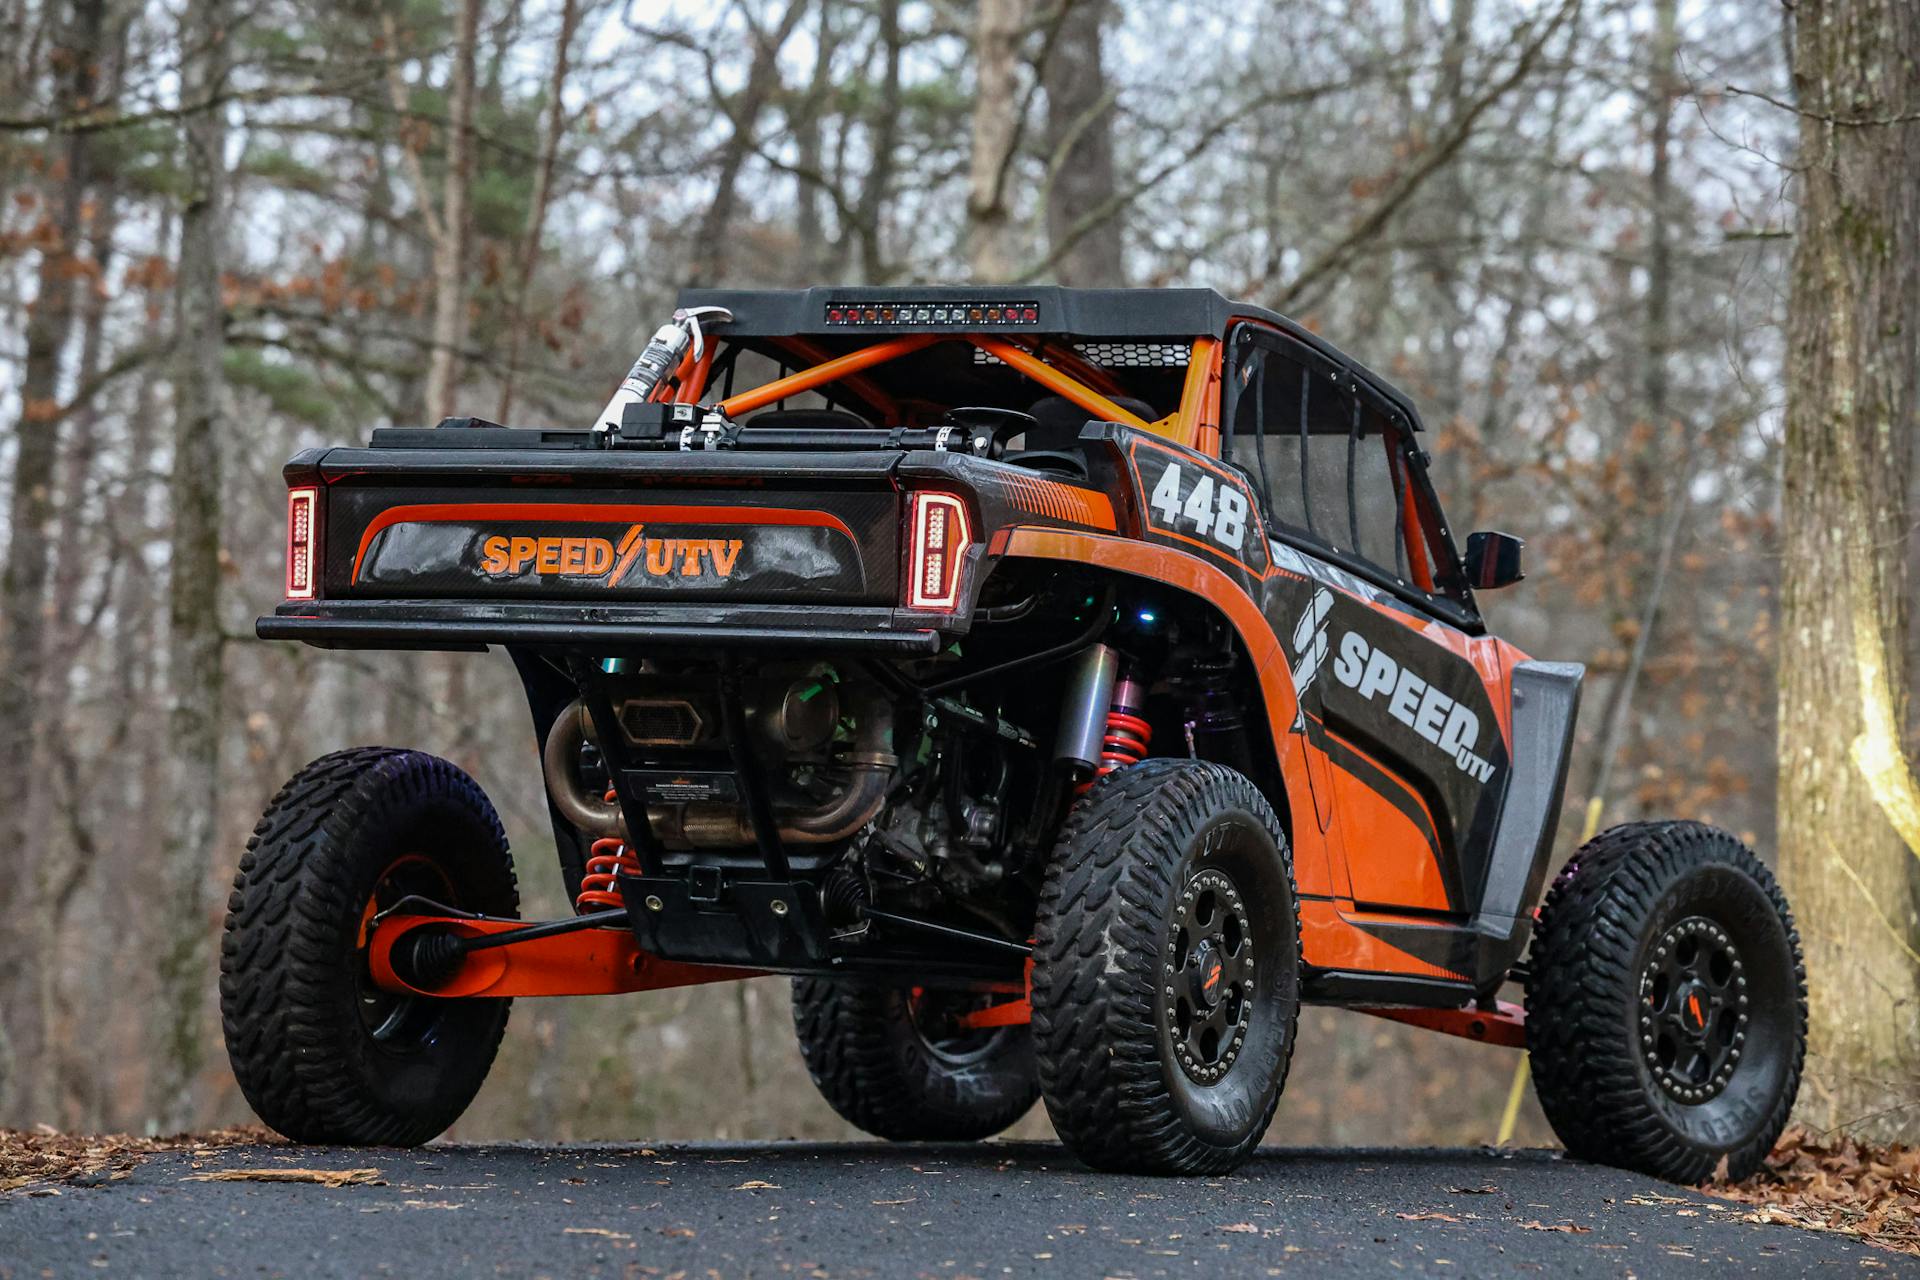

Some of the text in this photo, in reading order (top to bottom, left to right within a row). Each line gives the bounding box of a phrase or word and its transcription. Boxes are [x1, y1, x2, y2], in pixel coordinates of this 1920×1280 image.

[1150, 462, 1248, 550] 448
[481, 536, 743, 577] SPEED UTV
[1333, 631, 1496, 784] SPEED UTV
